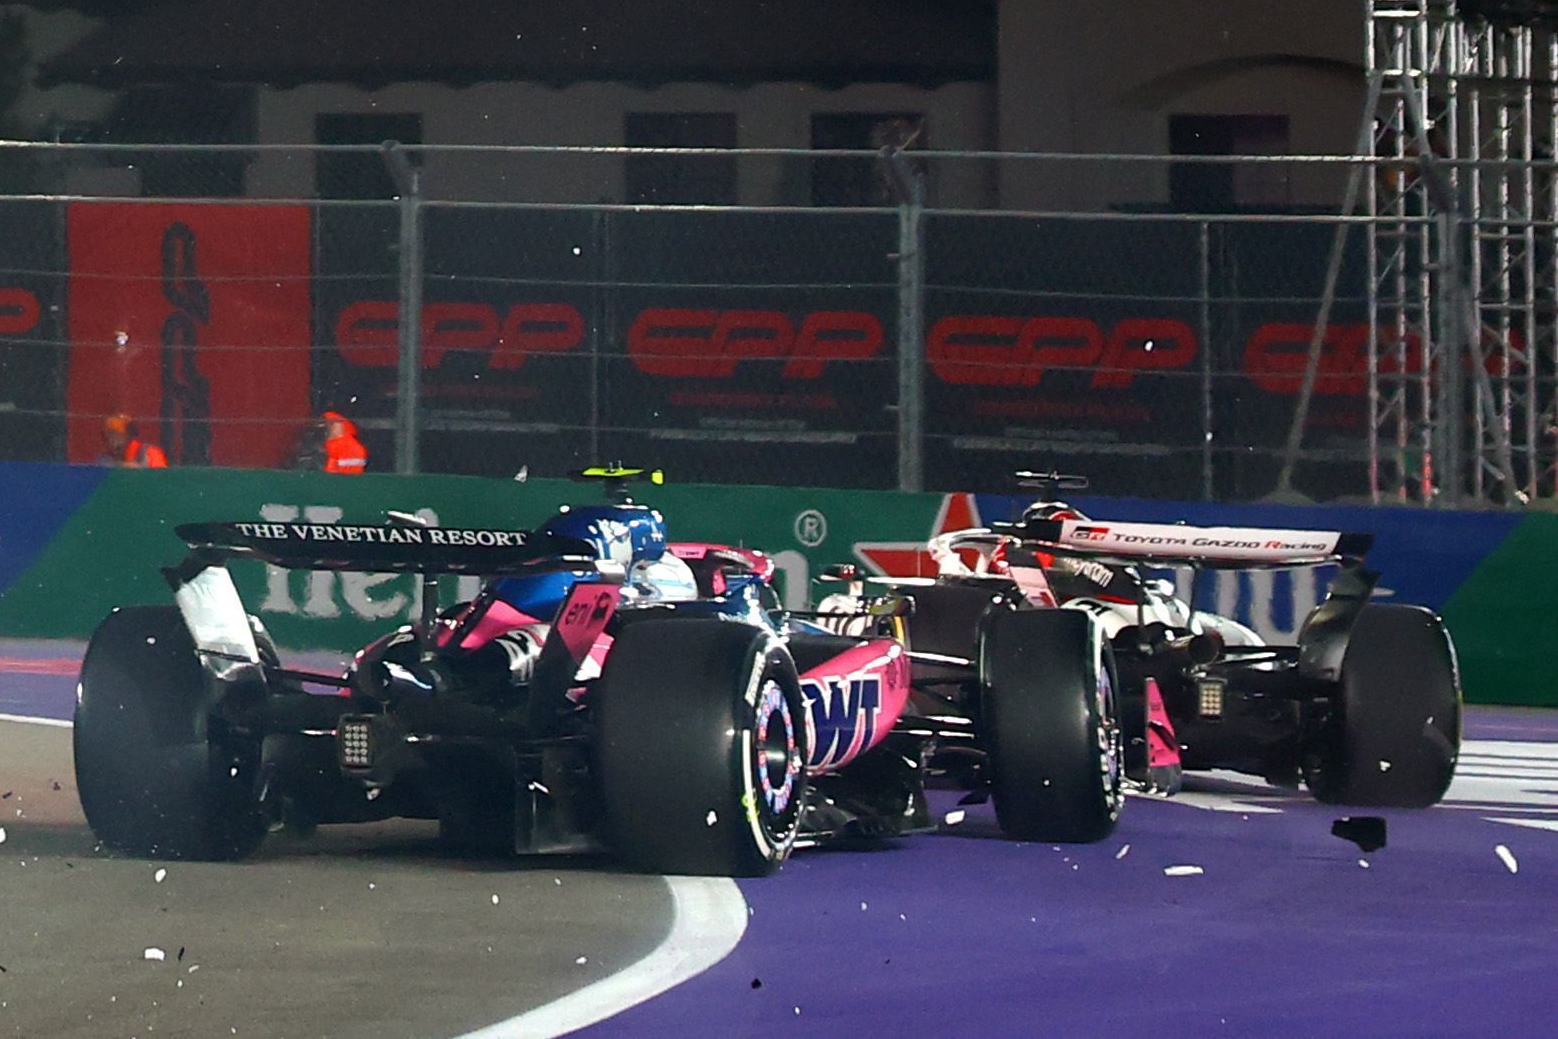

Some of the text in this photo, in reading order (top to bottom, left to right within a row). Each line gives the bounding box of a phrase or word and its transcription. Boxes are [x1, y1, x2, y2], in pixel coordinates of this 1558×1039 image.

[236, 523, 527, 546] THE VENETIAN RESORT
[1113, 532, 1186, 545] TOYOTA
